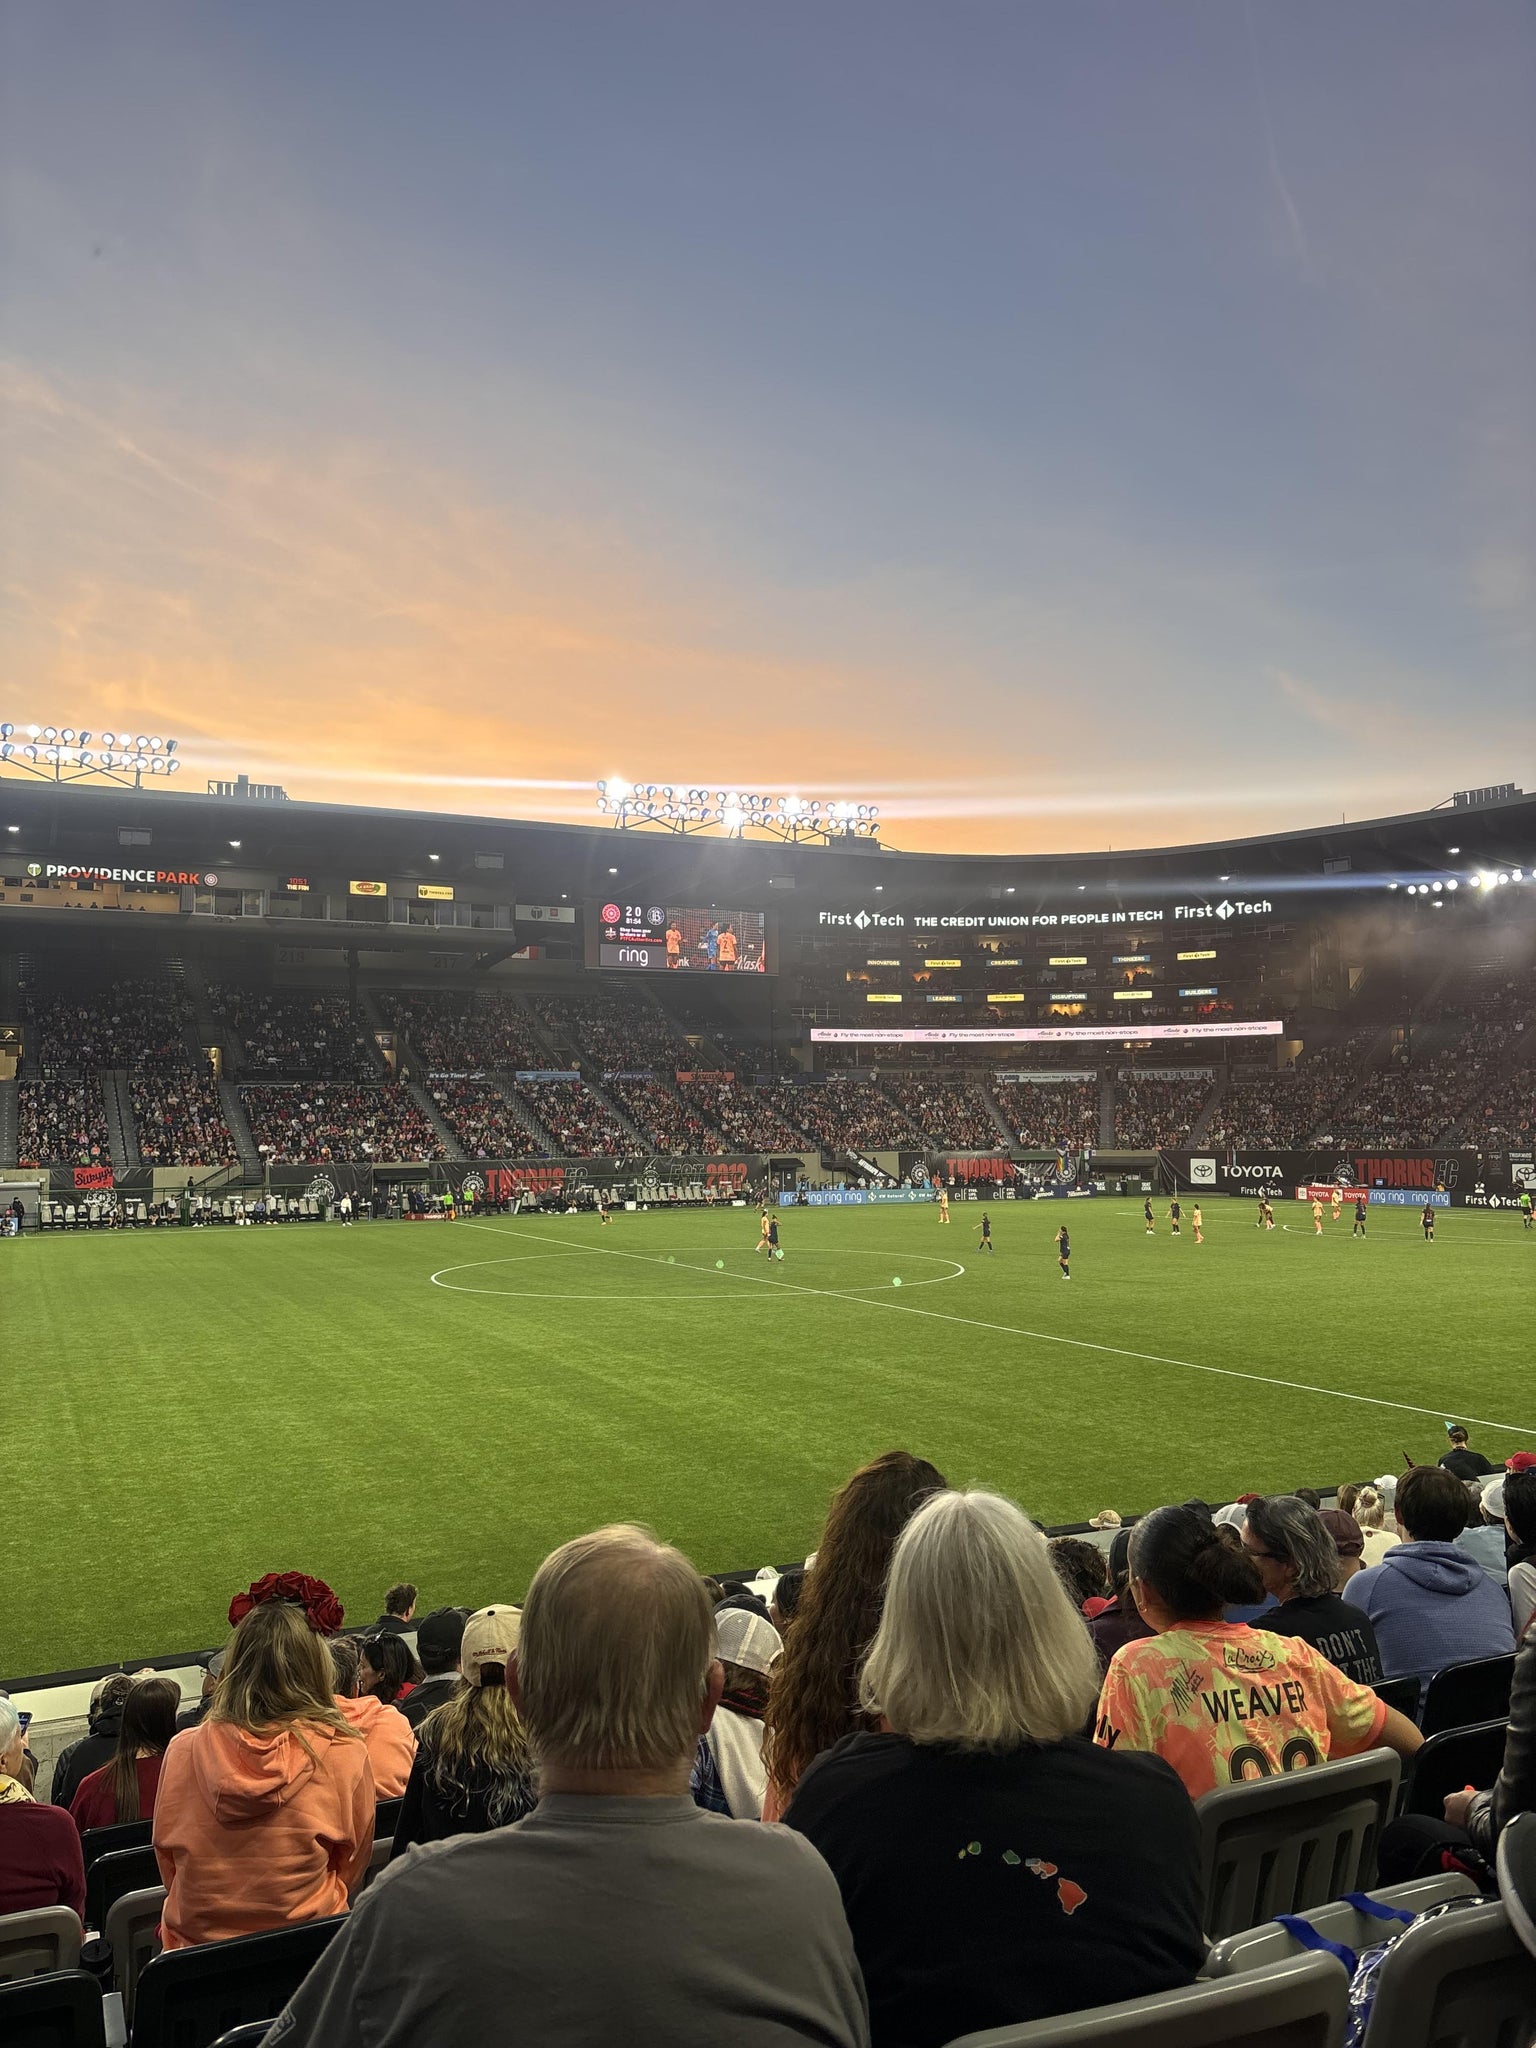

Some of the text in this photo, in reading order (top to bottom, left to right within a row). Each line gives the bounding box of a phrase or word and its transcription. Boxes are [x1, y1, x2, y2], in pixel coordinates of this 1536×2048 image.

[625, 906, 642, 917] 2 0
[819, 900, 1272, 927] First Tech THE CREDIT UNION FOR PEOPLE IN TECH First Tech
[619, 946, 649, 967] ring
[1221, 1165, 1284, 1178] TOYOTA
[1355, 1158, 1460, 1188] THORNS FC
[824, 1191, 842, 1204] ring
[844, 1190, 862, 1204] ring
[1240, 1186, 1283, 1197] First Tech
[1308, 1190, 1330, 1198] TOYOTA
[1344, 1192, 1367, 1200] TOYOTA
[1369, 1190, 1449, 1206] ring ring ring ring
[1465, 1194, 1488, 1205] First
[1315, 1628, 1368, 1661] DON'T
[1352, 1656, 1381, 1684] THE
[1201, 1680, 1309, 1724] WEAVER
